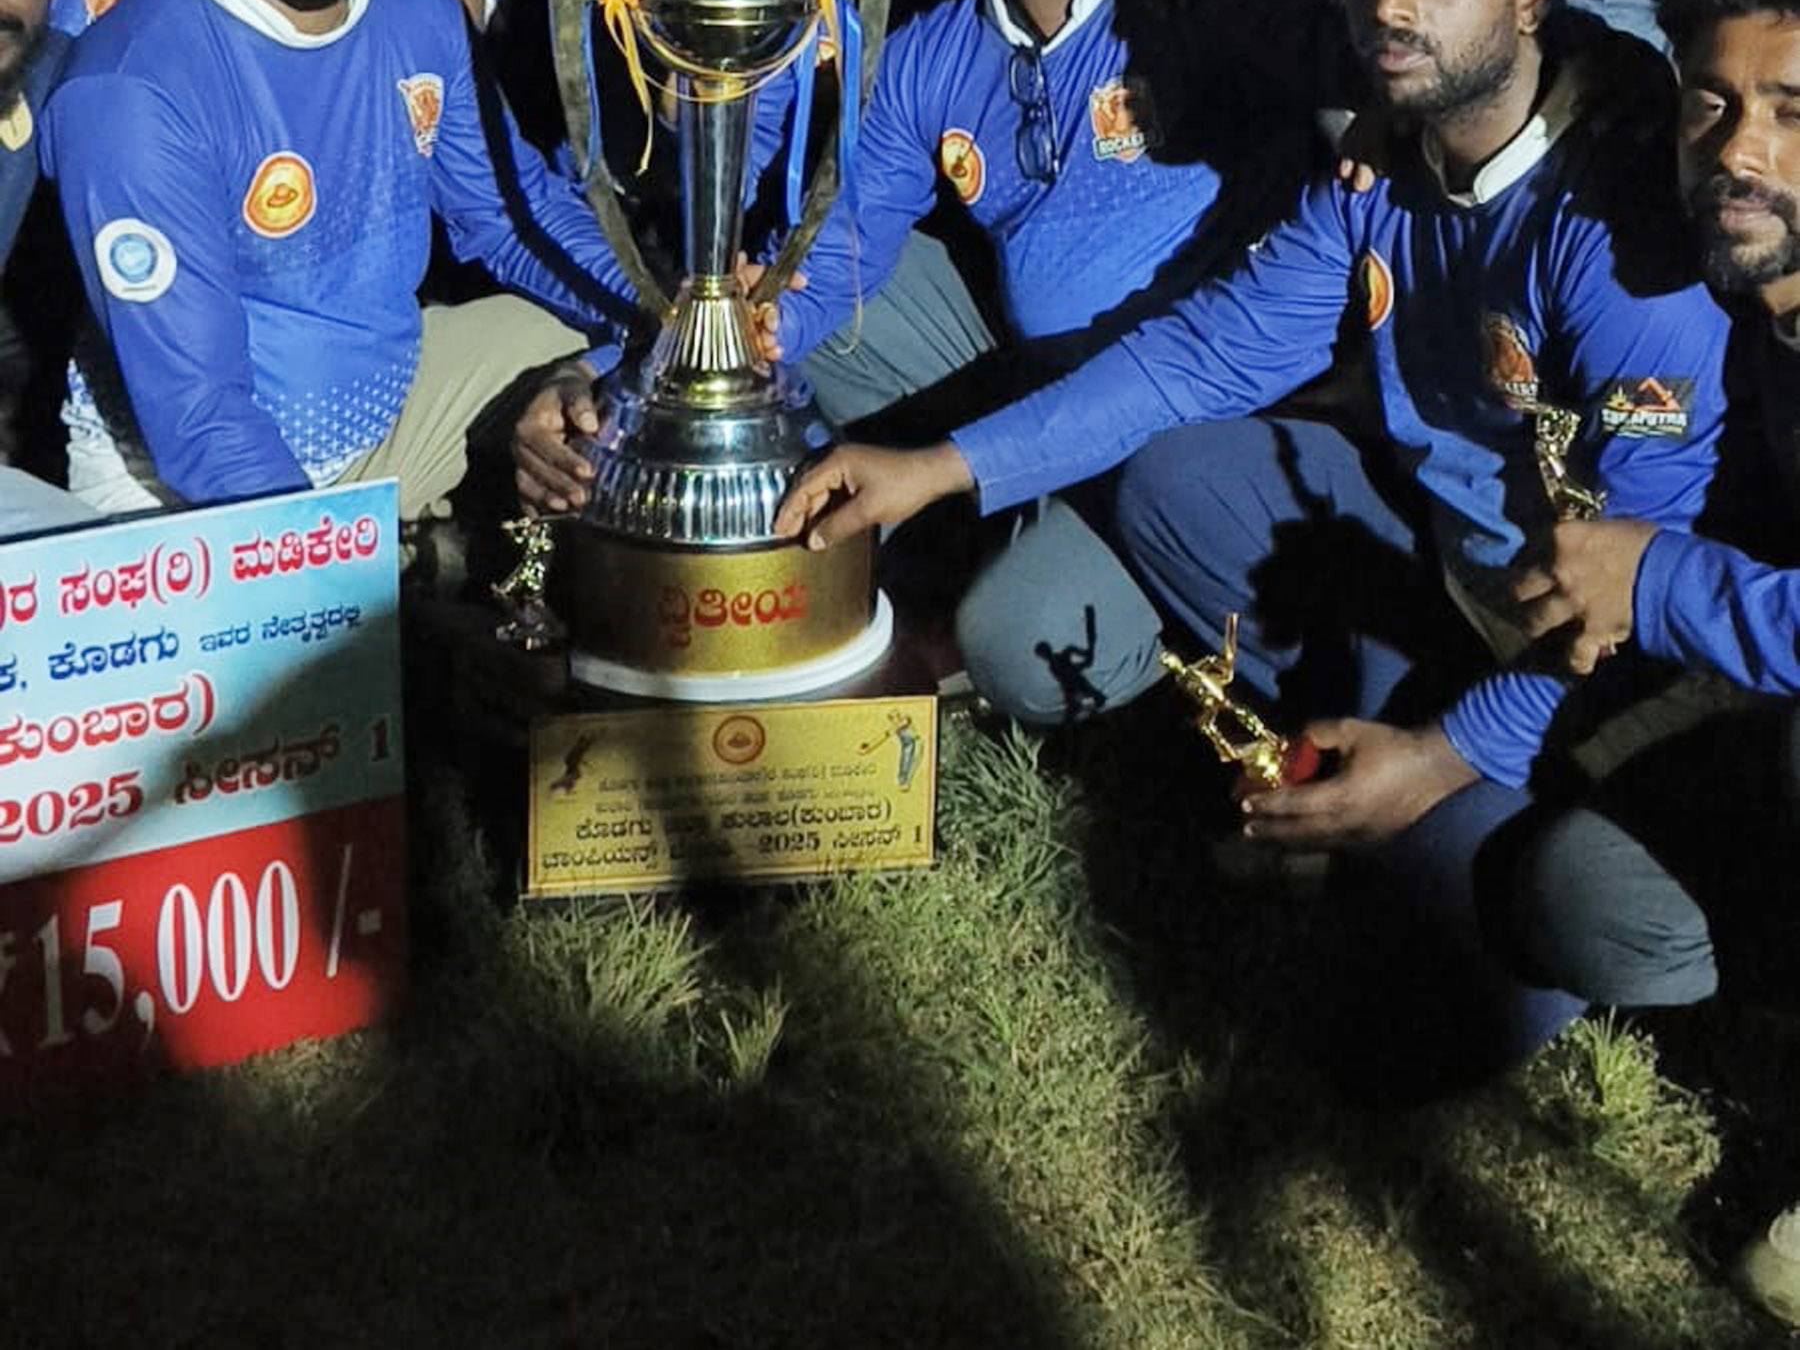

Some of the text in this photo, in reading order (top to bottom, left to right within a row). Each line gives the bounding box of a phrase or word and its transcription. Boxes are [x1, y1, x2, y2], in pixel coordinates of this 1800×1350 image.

[61, 537, 210, 614] ಸಂಘ(ರಿ)
[231, 517, 378, 580] ಮಡಿಕೇರಿ
[48, 626, 179, 680] ಕೊಡಗು
[199, 620, 250, 651] ಇವರ
[371, 721, 388, 762] 1
